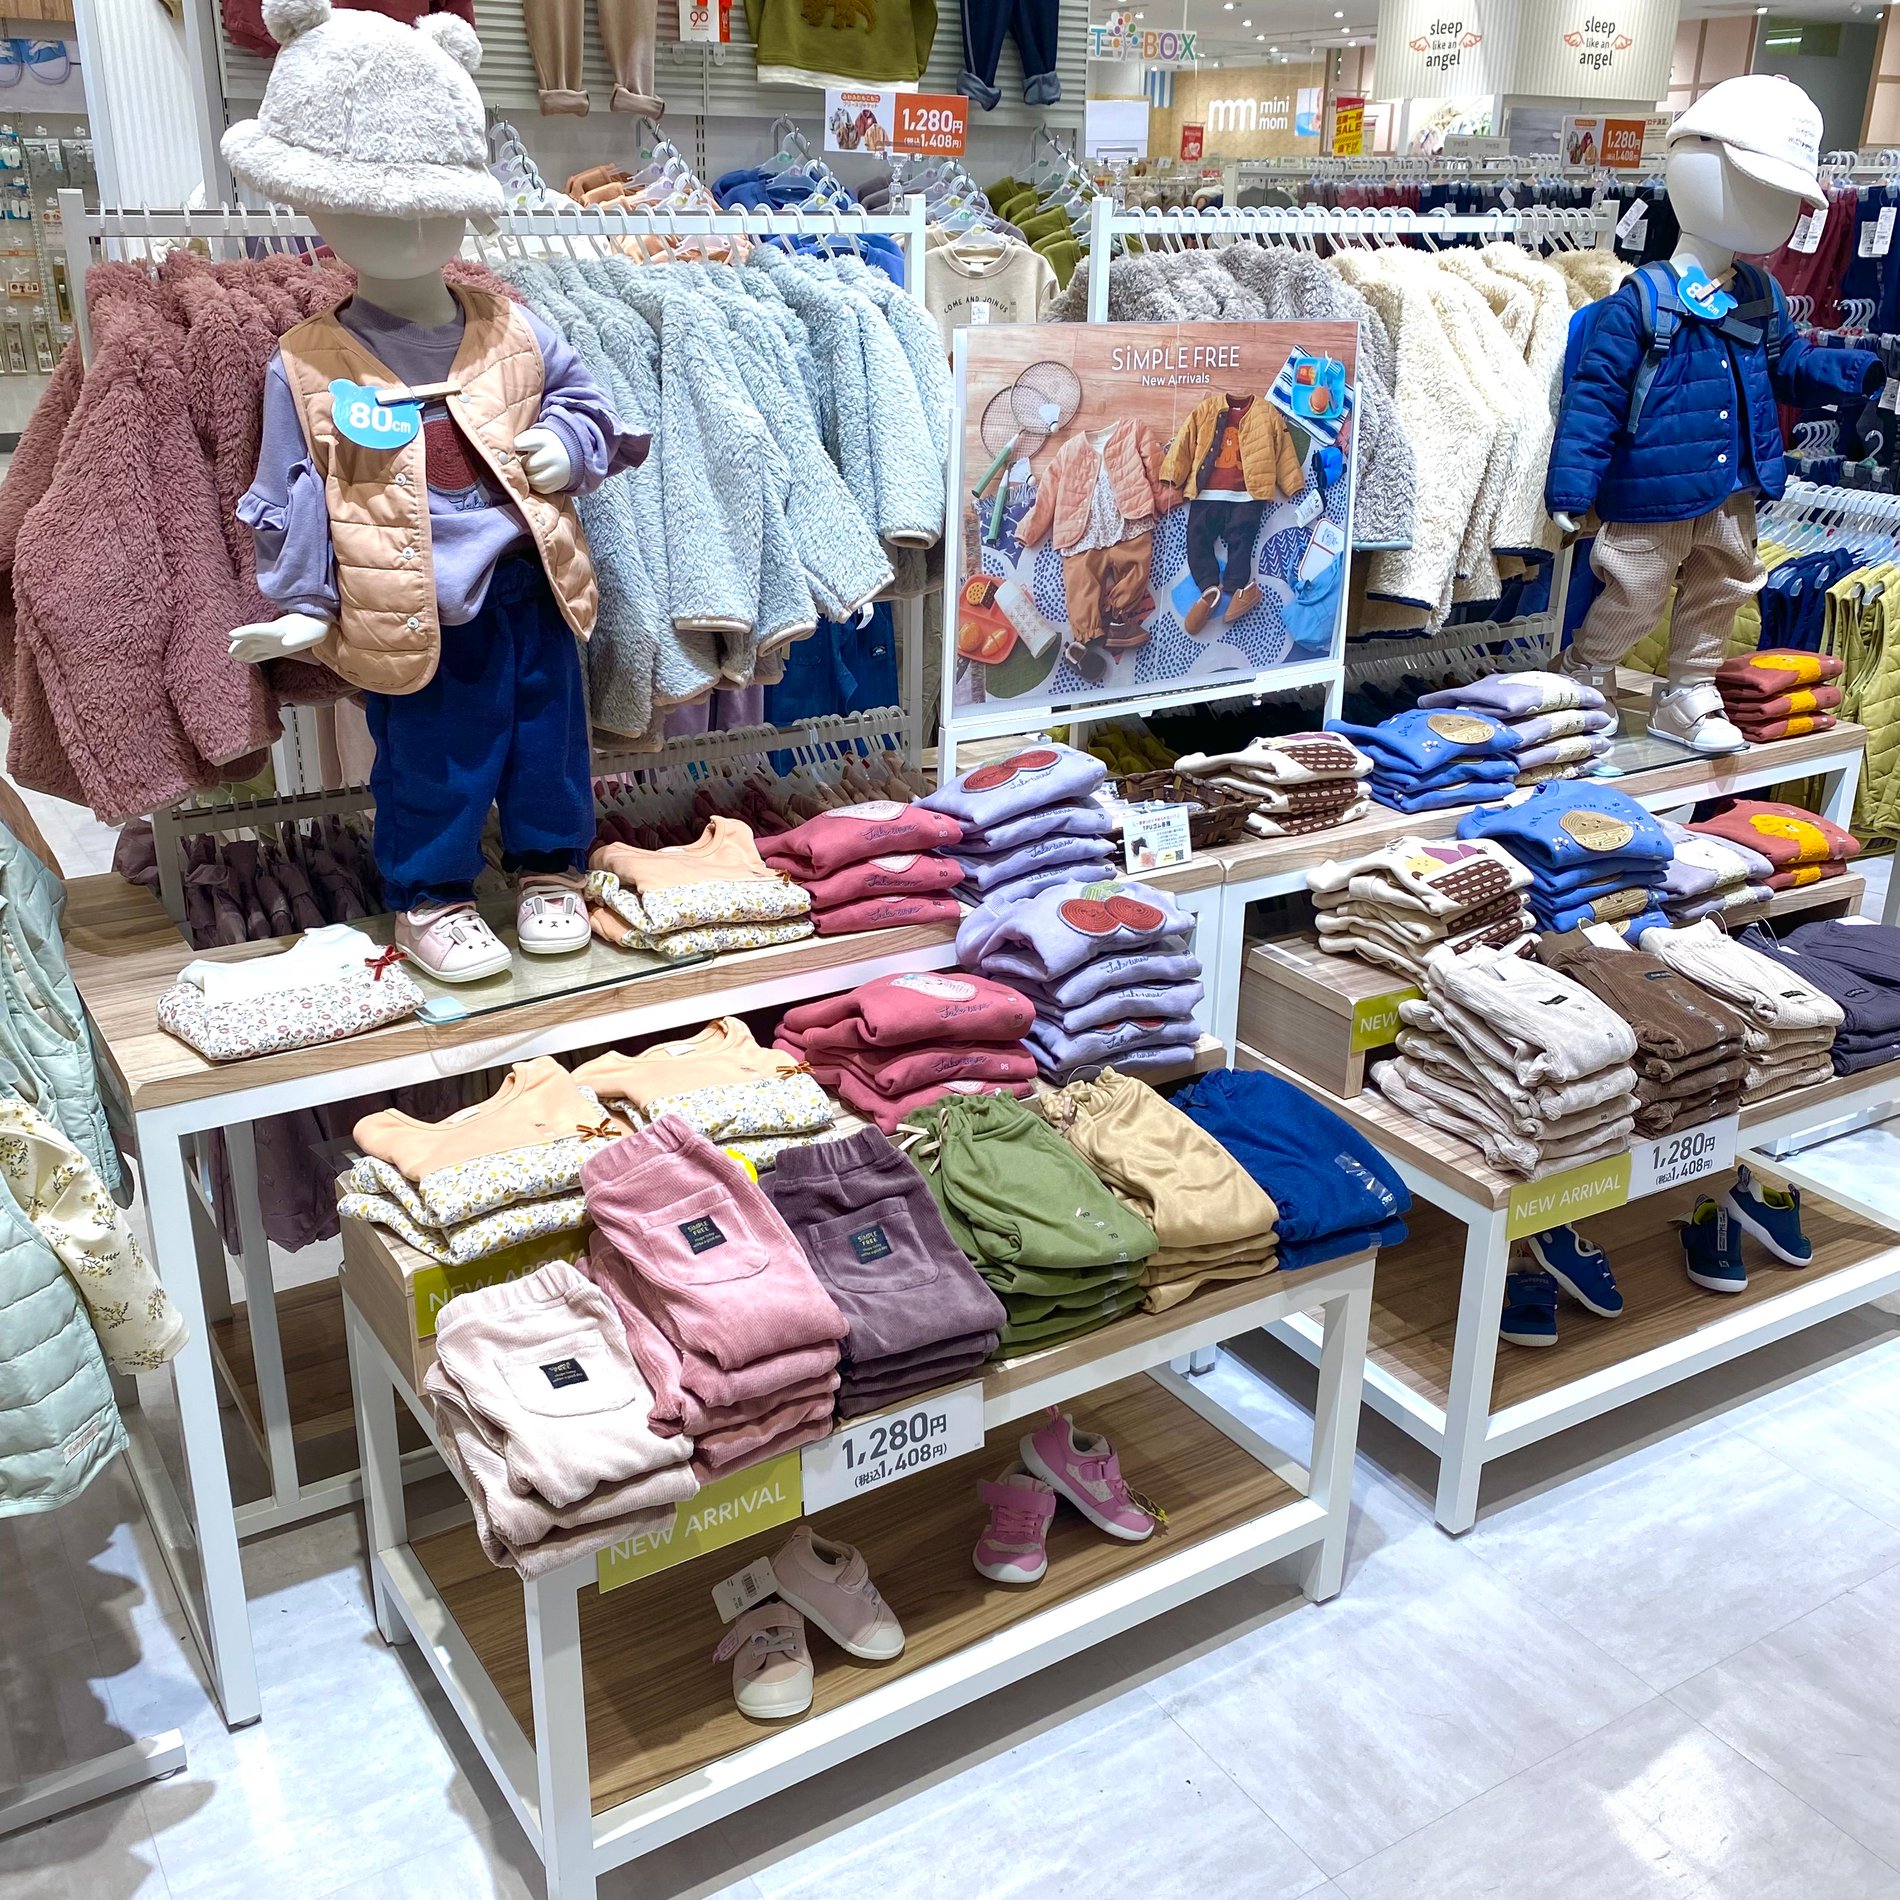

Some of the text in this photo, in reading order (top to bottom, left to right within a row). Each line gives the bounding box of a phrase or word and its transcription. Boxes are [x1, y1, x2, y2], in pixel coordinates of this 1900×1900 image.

[1430, 19, 1462, 37] sleep
[1584, 16, 1616, 38] sleep
[1432, 40, 1457, 50] like an
[1586, 38, 1610, 49] like an
[1426, 50, 1460, 71] angel
[1579, 50, 1612, 70] angel
[1260, 95, 1290, 114] mini
[902, 108, 963, 134] 1,280円
[1259, 115, 1288, 130] mom
[1336, 122, 1362, 136] SALE
[1607, 130, 1640, 149] 1,280円
[943, 299, 963, 314] COME
[982, 297, 999, 307] JOIN
[999, 304, 1009, 313] US
[1193, 346, 1240, 368] FREE
[1142, 372, 1210, 386] New Arrivals
[1360, 1012, 1399, 1034] NEW
[1652, 1132, 1716, 1170] 1,280円
[1656, 1158, 1713, 1186] (税込1,408円)
[1515, 1174, 1622, 1221] NEW ARRIVAL
[842, 1411, 947, 1470] 1,280円
[854, 1442, 947, 1489] (税込1,408円)
[684, 1482, 787, 1538] ARRIVAL
